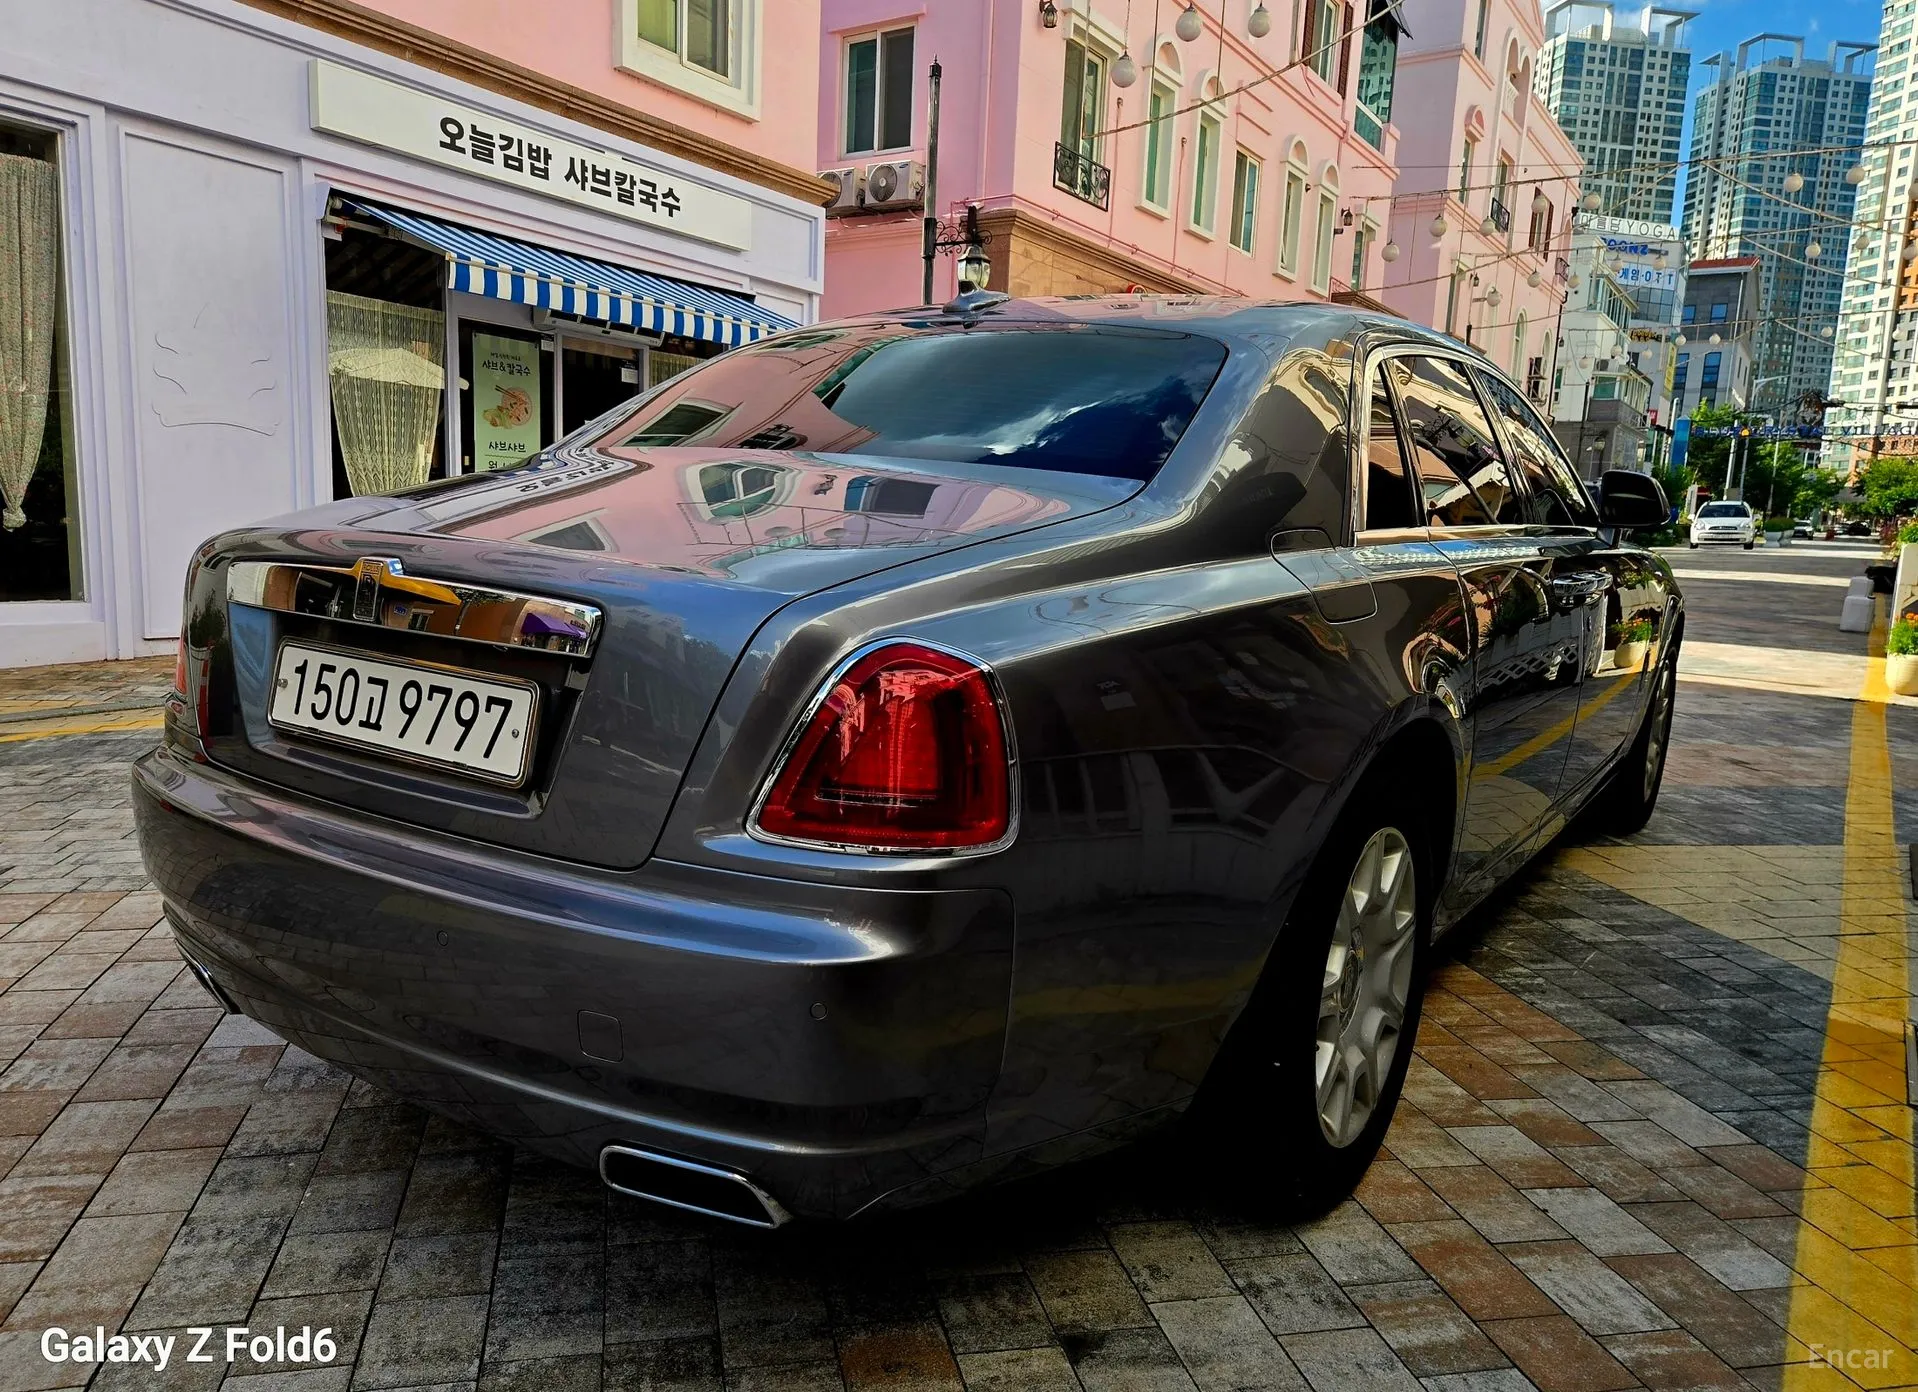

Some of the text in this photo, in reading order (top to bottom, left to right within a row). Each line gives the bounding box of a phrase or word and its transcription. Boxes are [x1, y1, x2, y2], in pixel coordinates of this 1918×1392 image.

[439, 116, 681, 218] 오늘김밥 샤브칼국수
[482, 359, 531, 377] 샤브&칼국수
[488, 441, 527, 453] 샤브샤브
